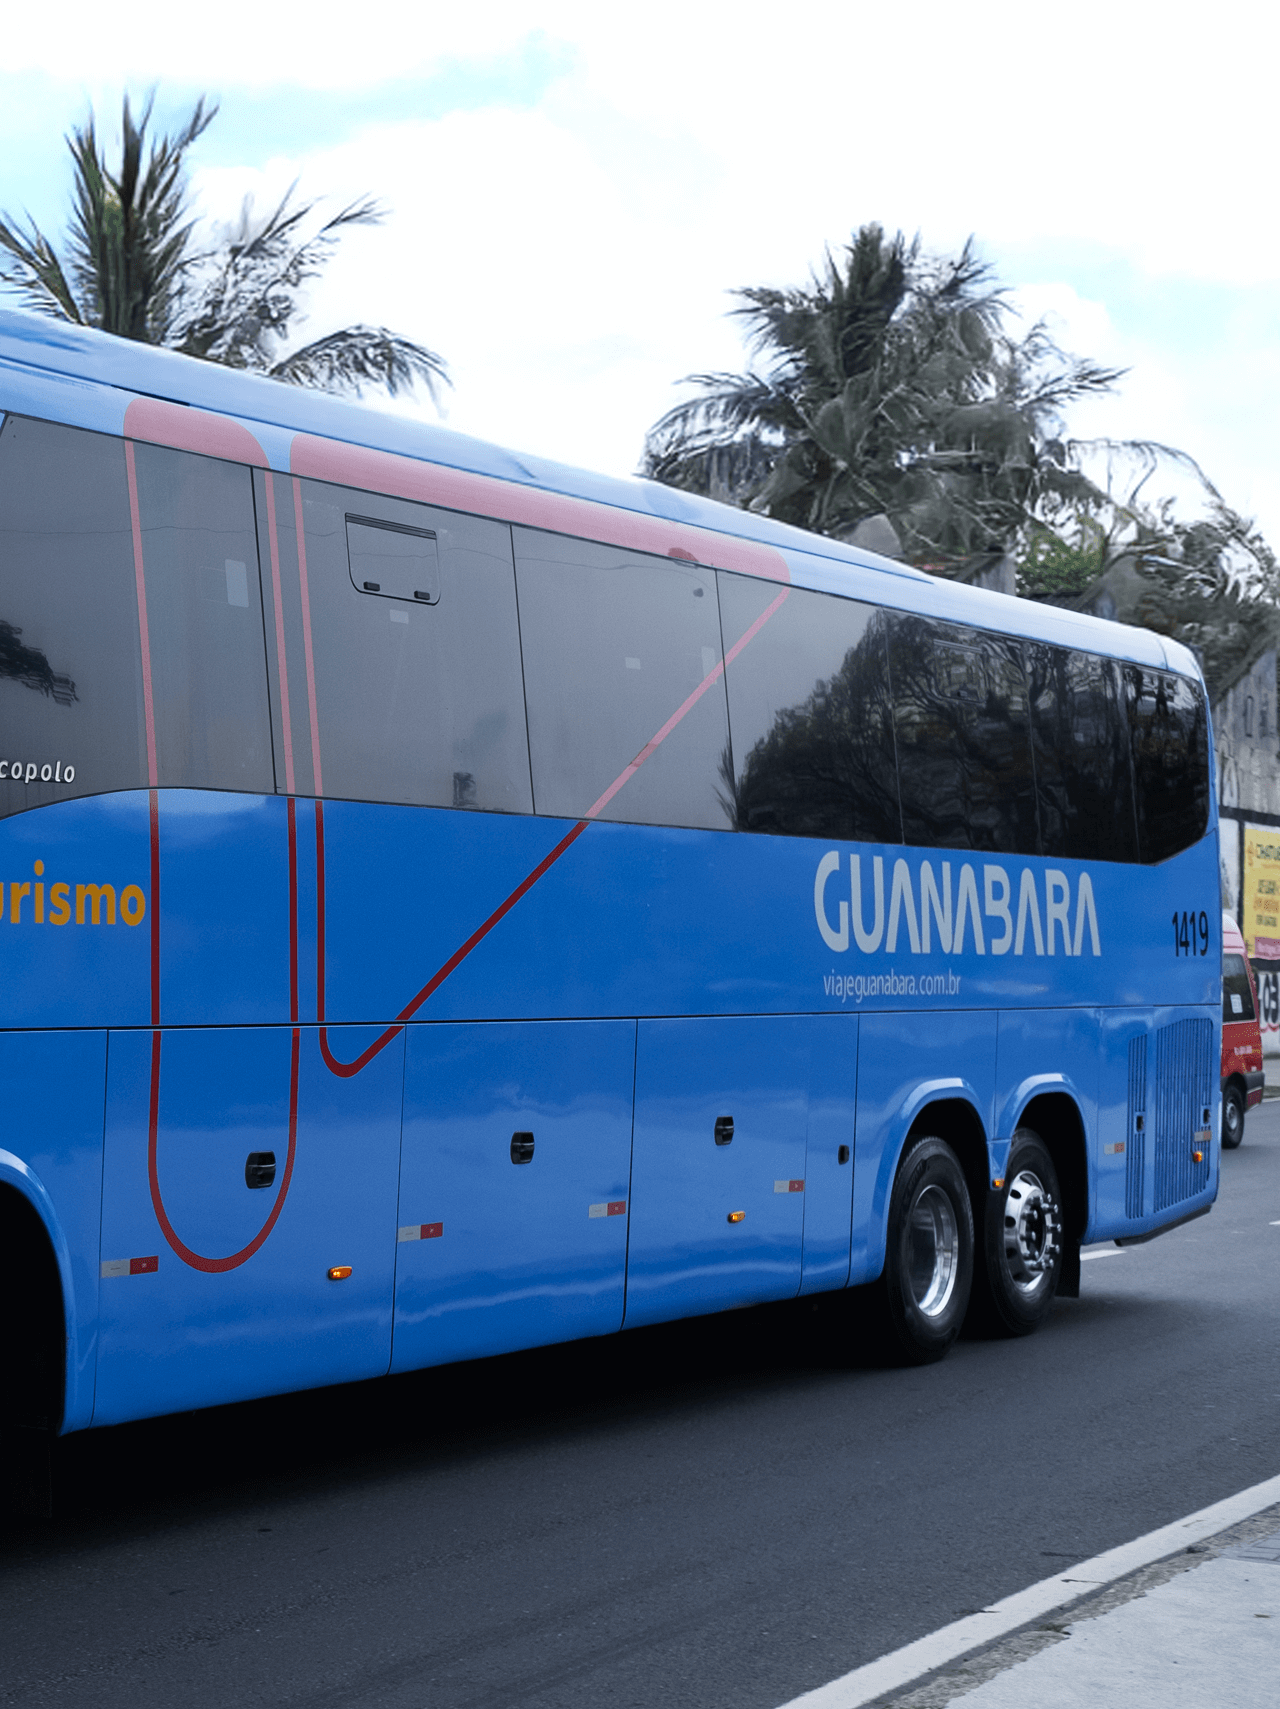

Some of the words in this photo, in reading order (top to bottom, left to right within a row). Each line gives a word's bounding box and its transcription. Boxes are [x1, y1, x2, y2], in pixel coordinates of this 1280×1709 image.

[813, 850, 1102, 956] GUANABARA
[1172, 911, 1209, 957] 1419
[823, 968, 961, 1004] viajeguanabara.com.br
